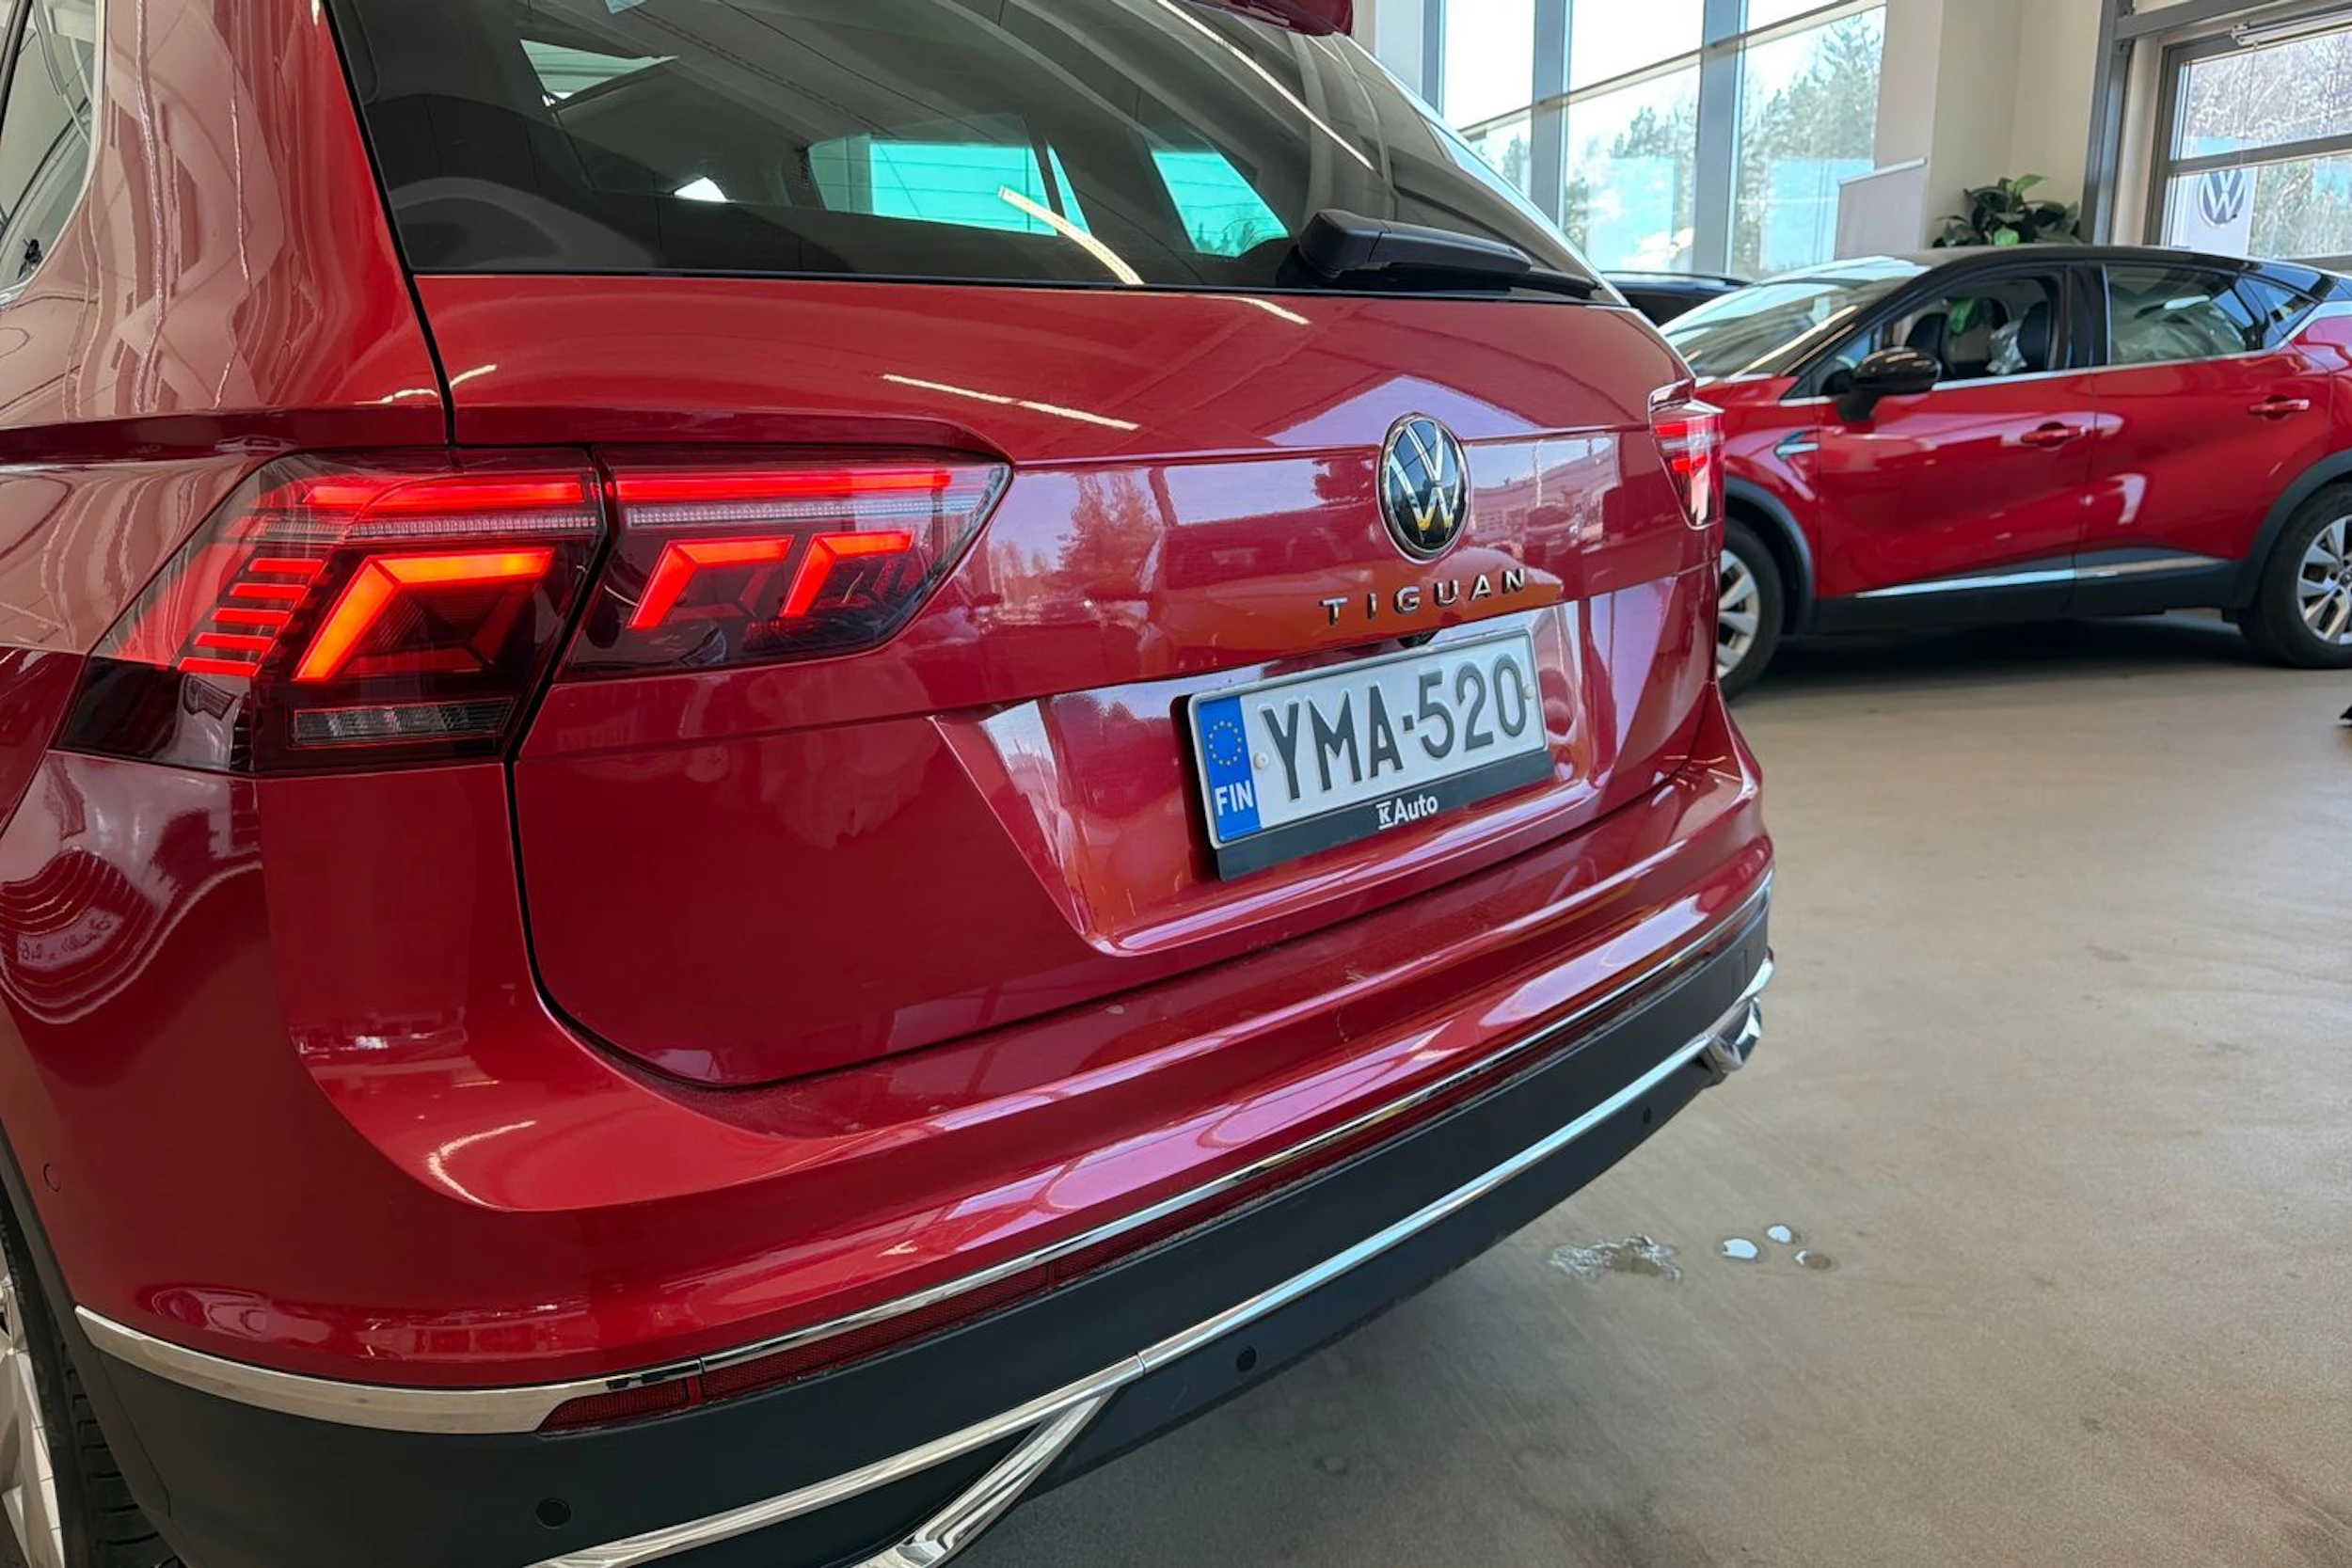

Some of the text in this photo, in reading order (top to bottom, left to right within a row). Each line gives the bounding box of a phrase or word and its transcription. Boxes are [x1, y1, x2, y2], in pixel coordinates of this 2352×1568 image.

[1319, 568, 1526, 625] TIGUAN
[1262, 653, 1527, 800] YMA-520
[1215, 780, 1254, 816] FIN
